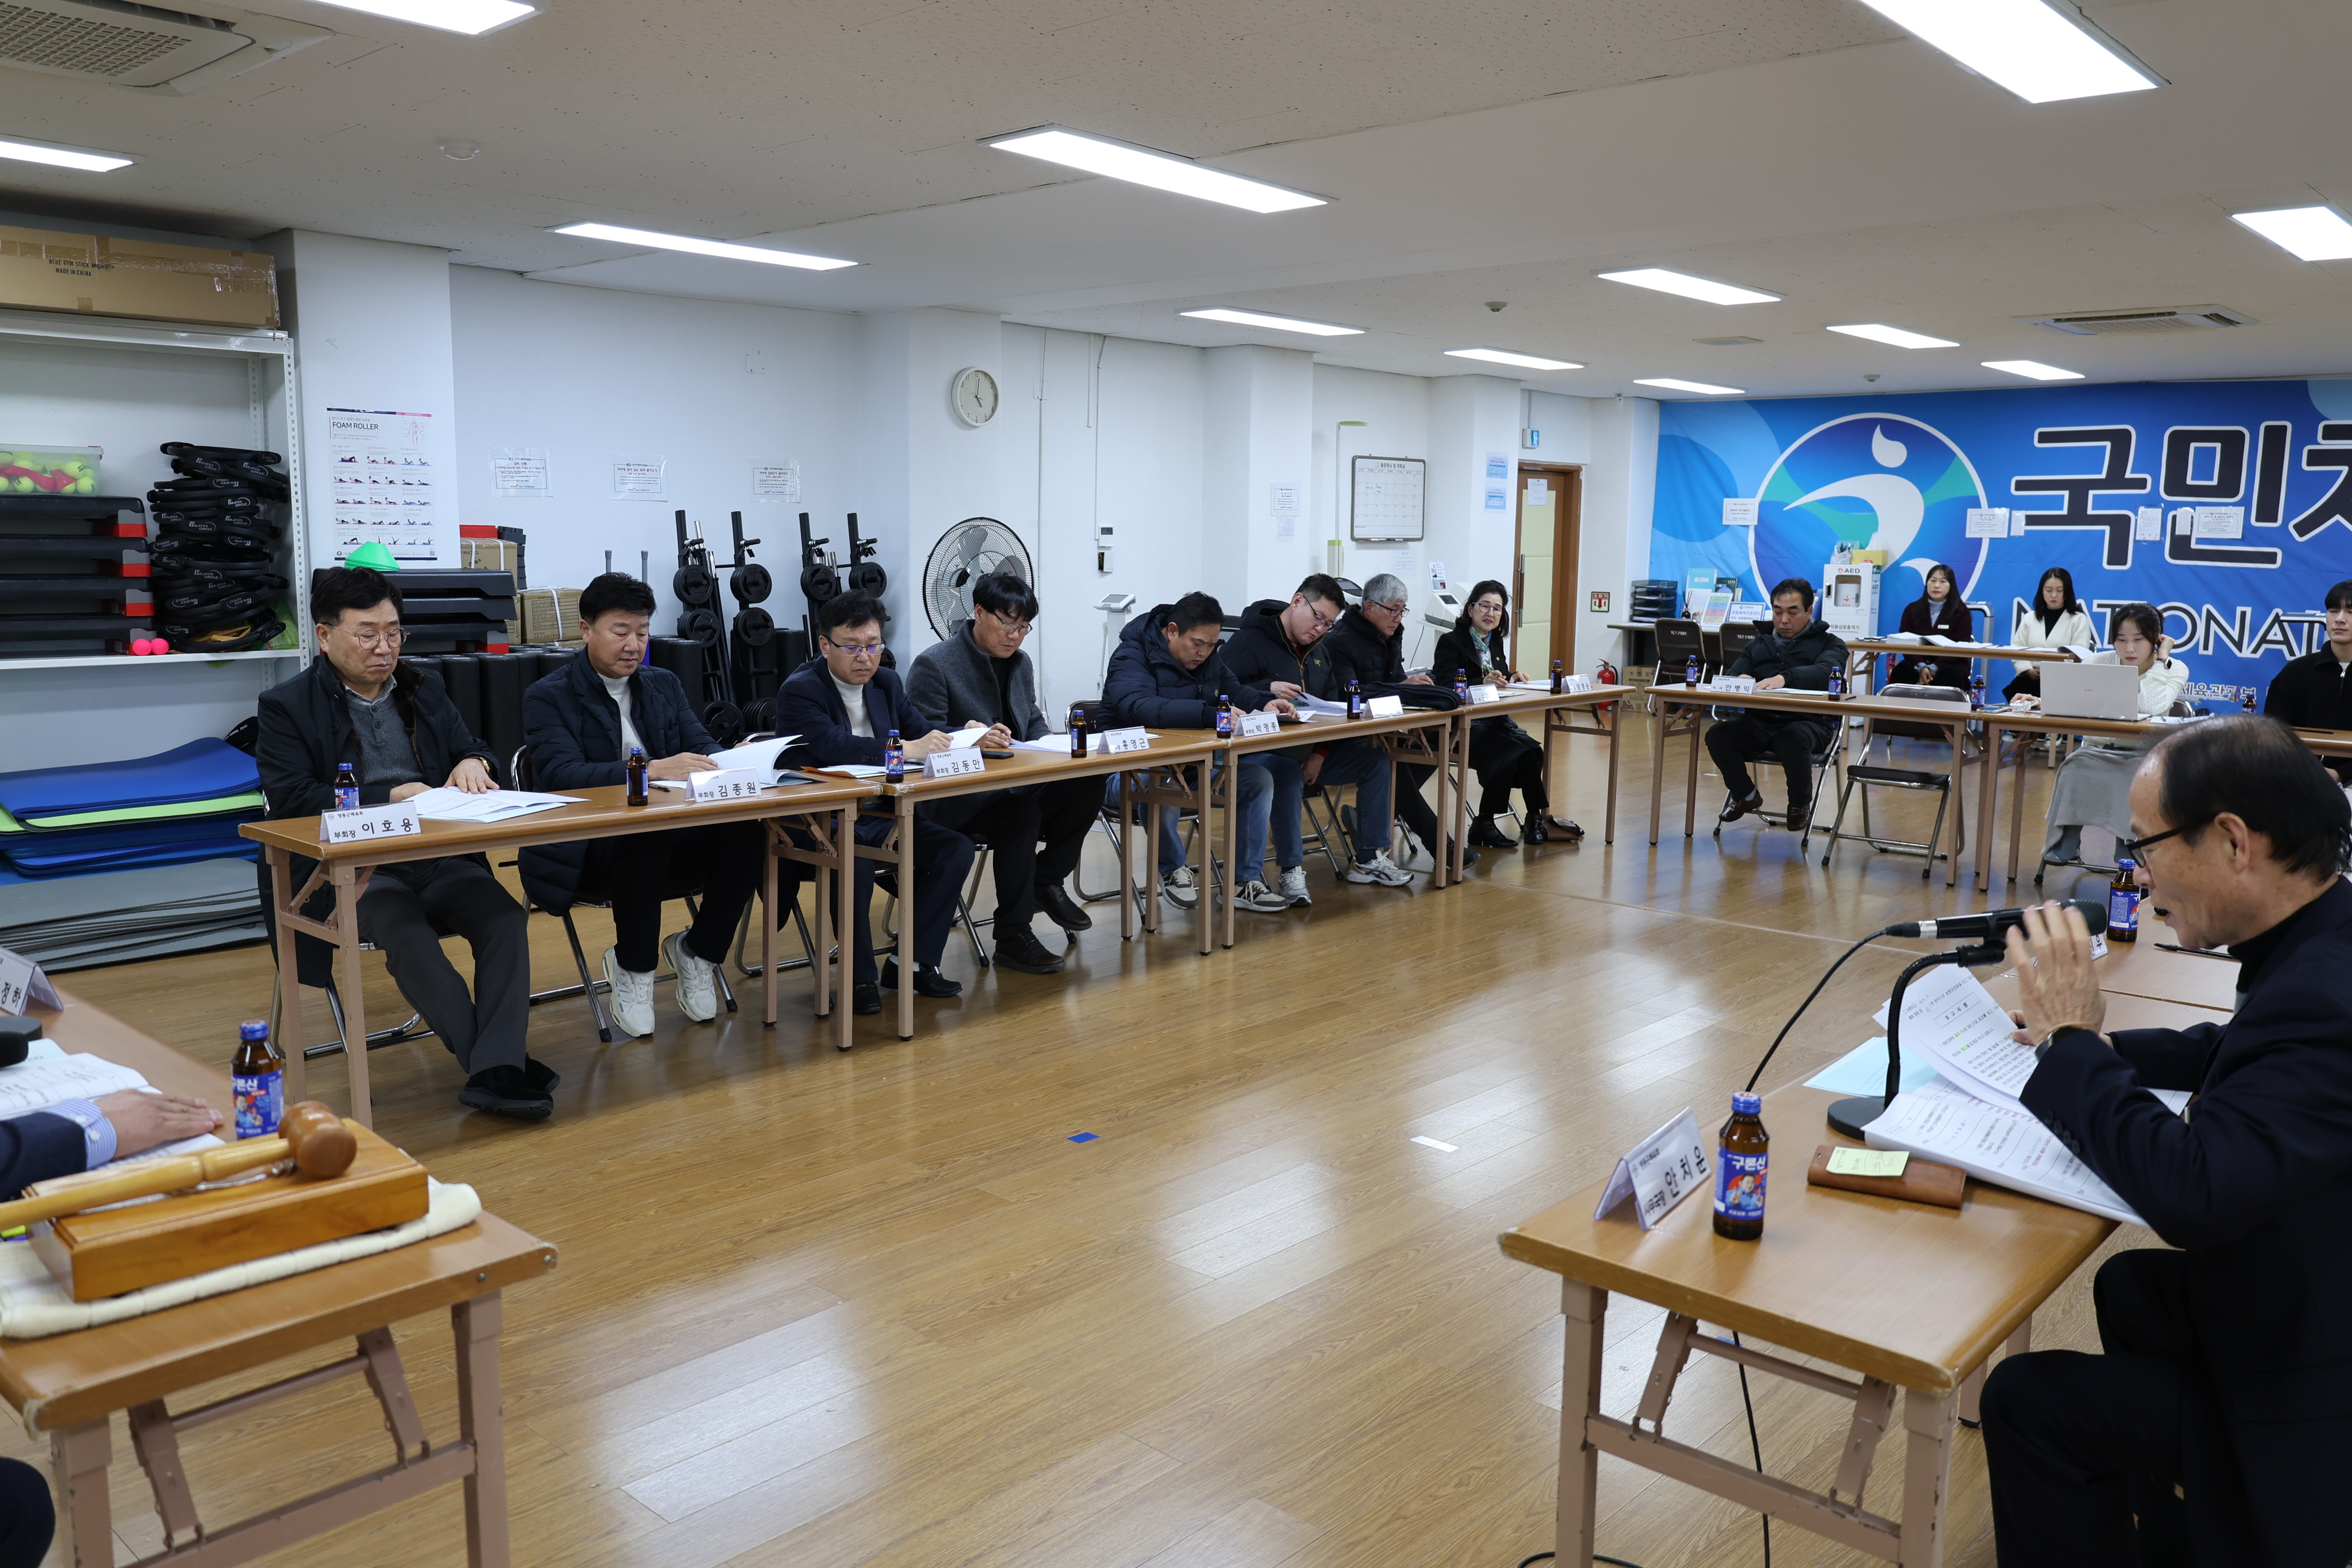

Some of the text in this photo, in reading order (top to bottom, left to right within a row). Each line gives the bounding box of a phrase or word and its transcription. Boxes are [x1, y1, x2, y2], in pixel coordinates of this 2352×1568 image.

[196, 458, 214, 467] PILATES
[243, 462, 260, 472] PILATES
[1725, 684, 1750, 693] 안병익
[1255, 722, 1277, 733] 박명종
[1122, 738, 1146, 750] 홍영근
[951, 759, 981, 773] 김동만
[718, 781, 757, 798] 김종원
[334, 818, 413, 839] 부회장 이호용
